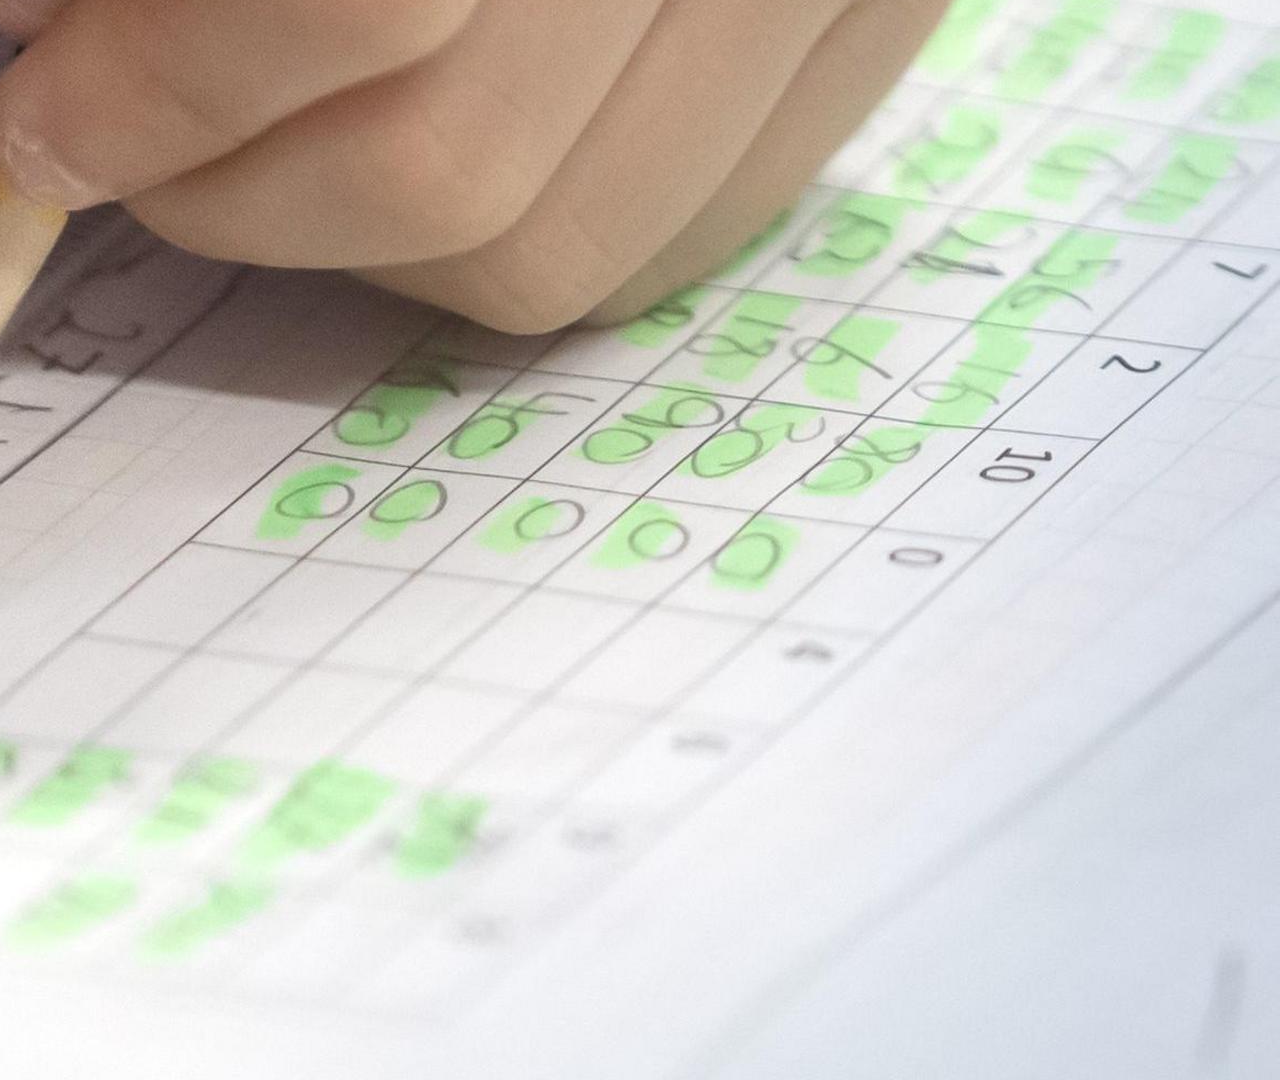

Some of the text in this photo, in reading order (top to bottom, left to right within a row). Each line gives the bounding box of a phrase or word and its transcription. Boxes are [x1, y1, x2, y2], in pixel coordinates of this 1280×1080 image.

[1006, 253, 1123, 311] 56
[686, 314, 796, 358] 18
[791, 335, 894, 380] 6
[911, 360, 1022, 405] 16
[581, 395, 726, 466] 90
[888, 259, 1268, 568] 7 2 10 0
[368, 390, 596, 524] 40 0
[690, 404, 827, 479] 30
[798, 433, 922, 493] 80
[274, 480, 356, 520] 0
[514, 498, 586, 541] 0
[627, 518, 690, 560] 0
[711, 532, 782, 582] 0
